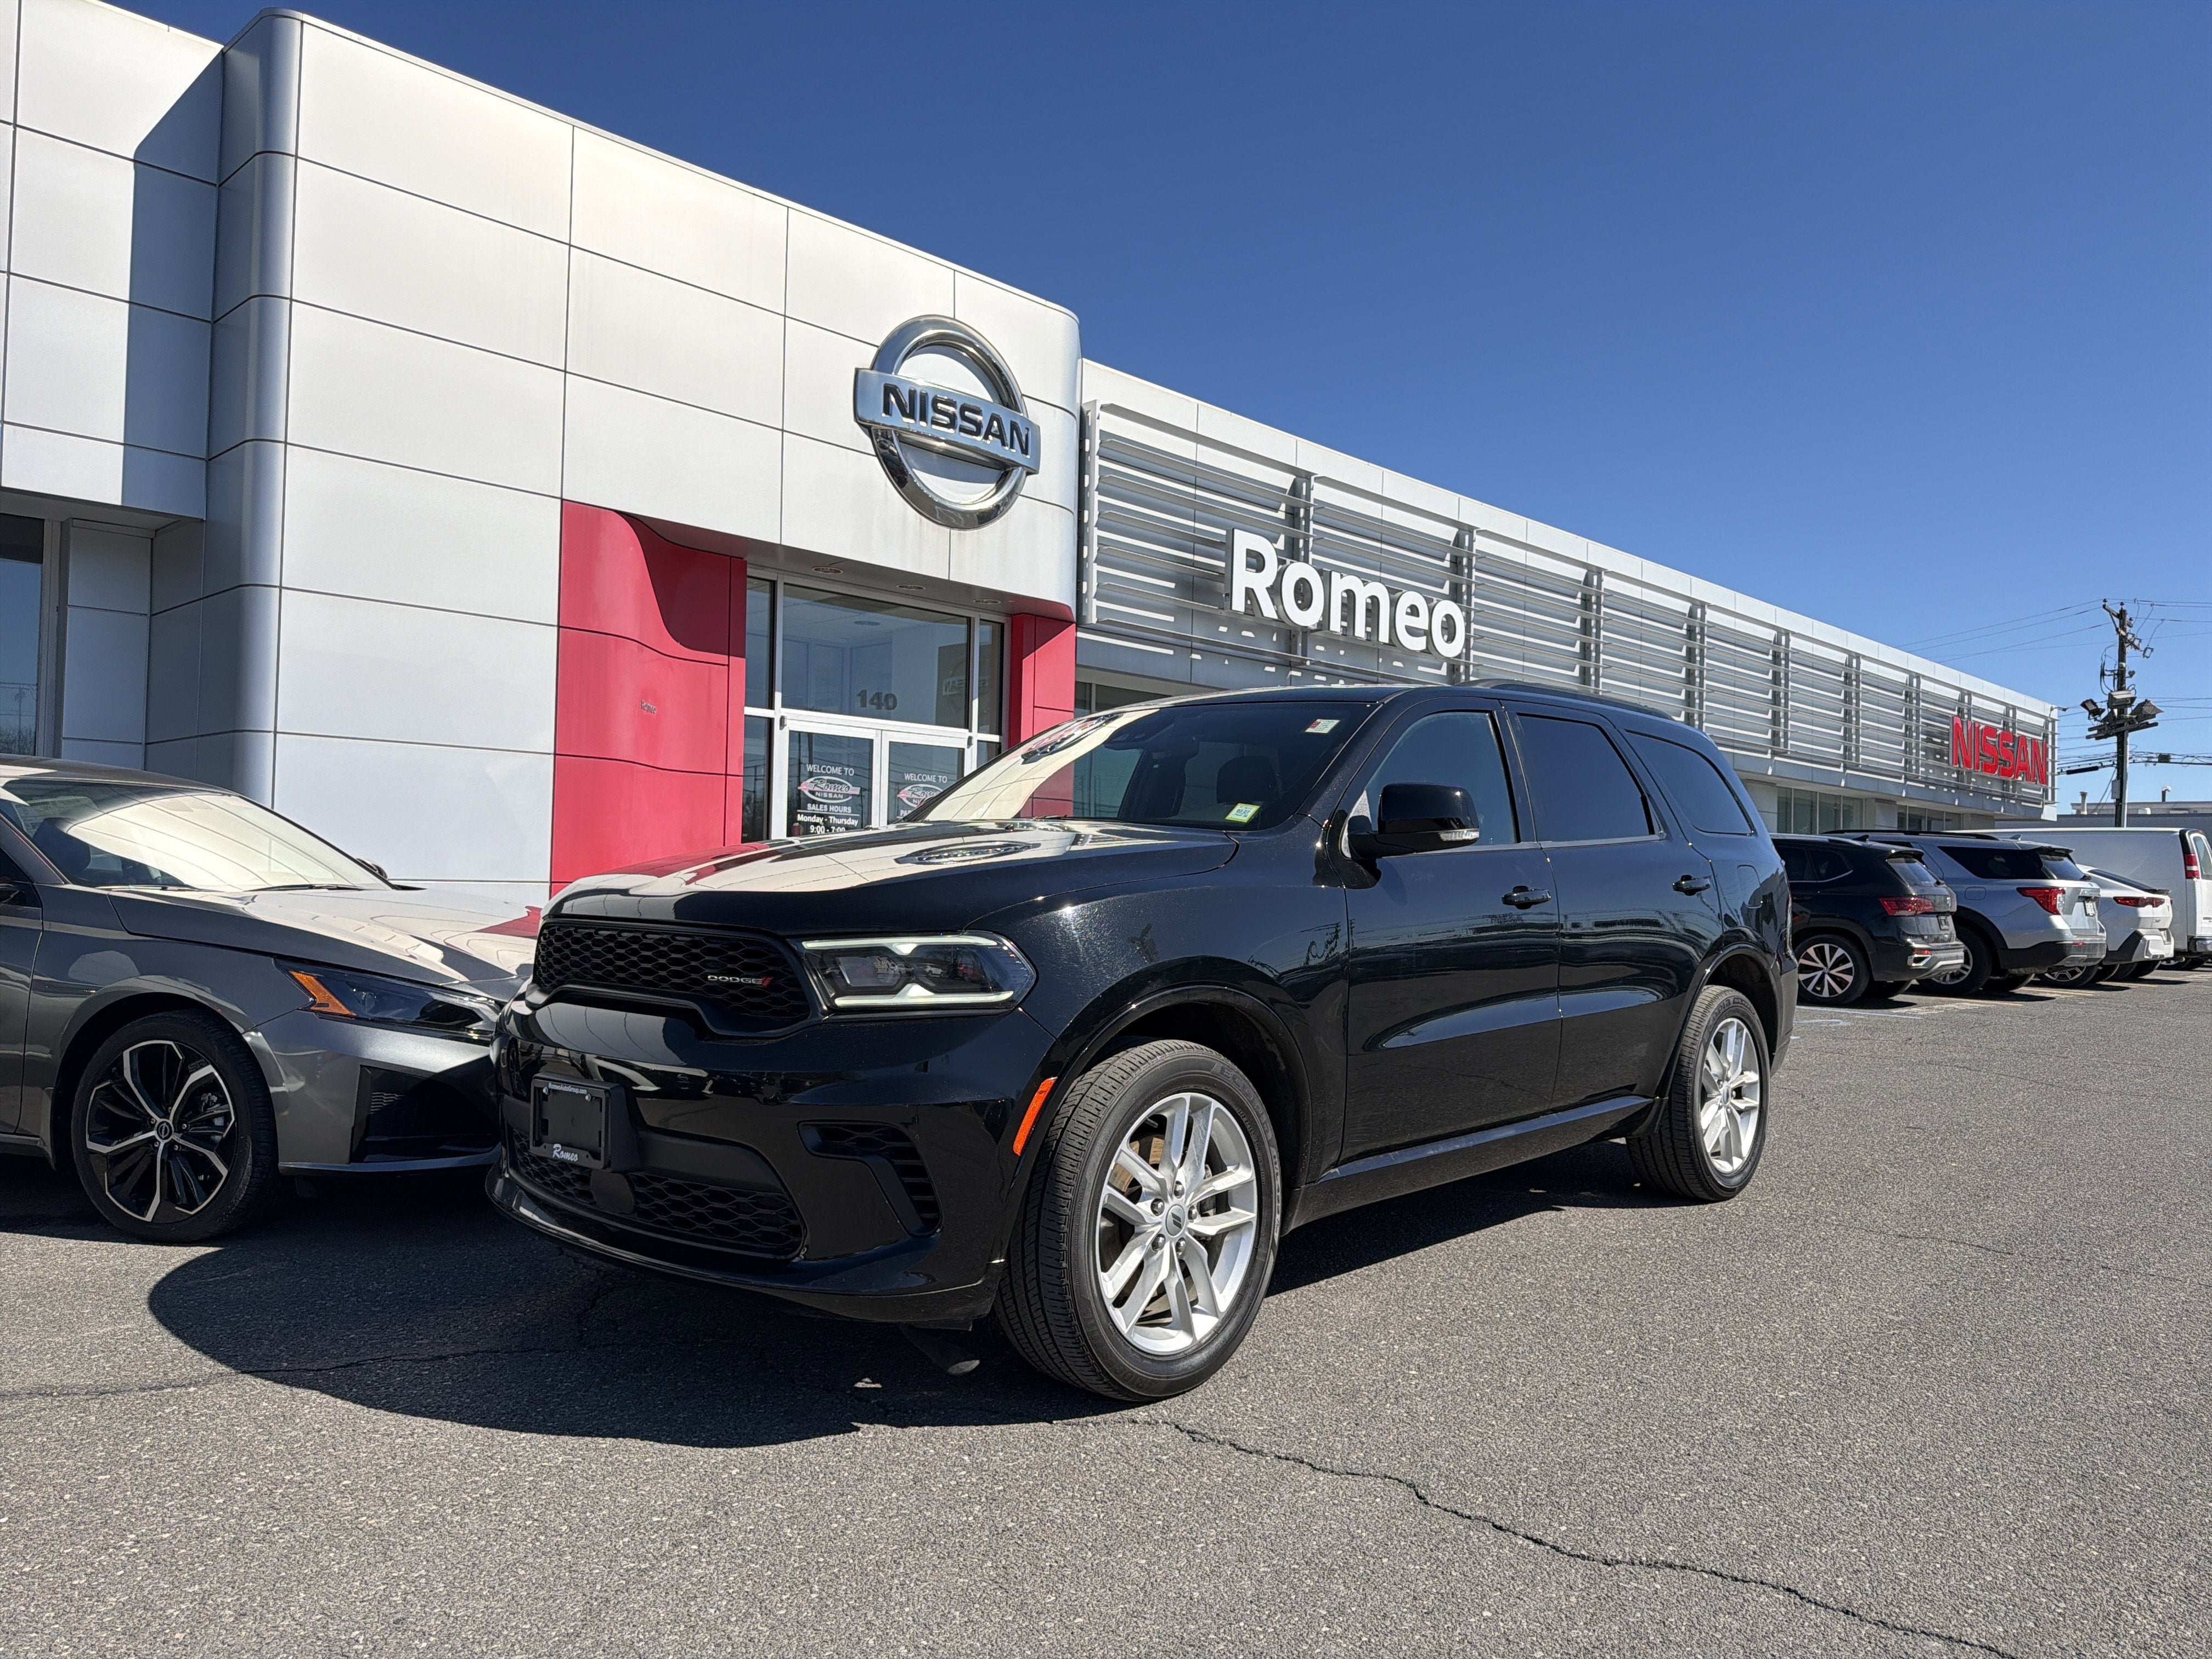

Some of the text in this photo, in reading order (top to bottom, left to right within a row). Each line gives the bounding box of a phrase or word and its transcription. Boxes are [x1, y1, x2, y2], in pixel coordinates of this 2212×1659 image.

[882, 383, 1030, 458] NISSAN
[1230, 528, 1465, 658] Romeo
[856, 689, 898, 710] 140
[1952, 716, 2048, 786] NISSAN
[806, 764, 855, 776] WELCOME TO
[904, 772, 947, 783] WELCOME TO
[812, 778, 850, 792] Romeo
[909, 786, 940, 798] Rom
[807, 803, 852, 813] SALES HOURS
[797, 814, 823, 825] Monday
[828, 816, 859, 827] Thursday
[810, 825, 825, 834] 9:00
[707, 975, 763, 984] DODGE
[552, 1143, 578, 1162] Romeo
